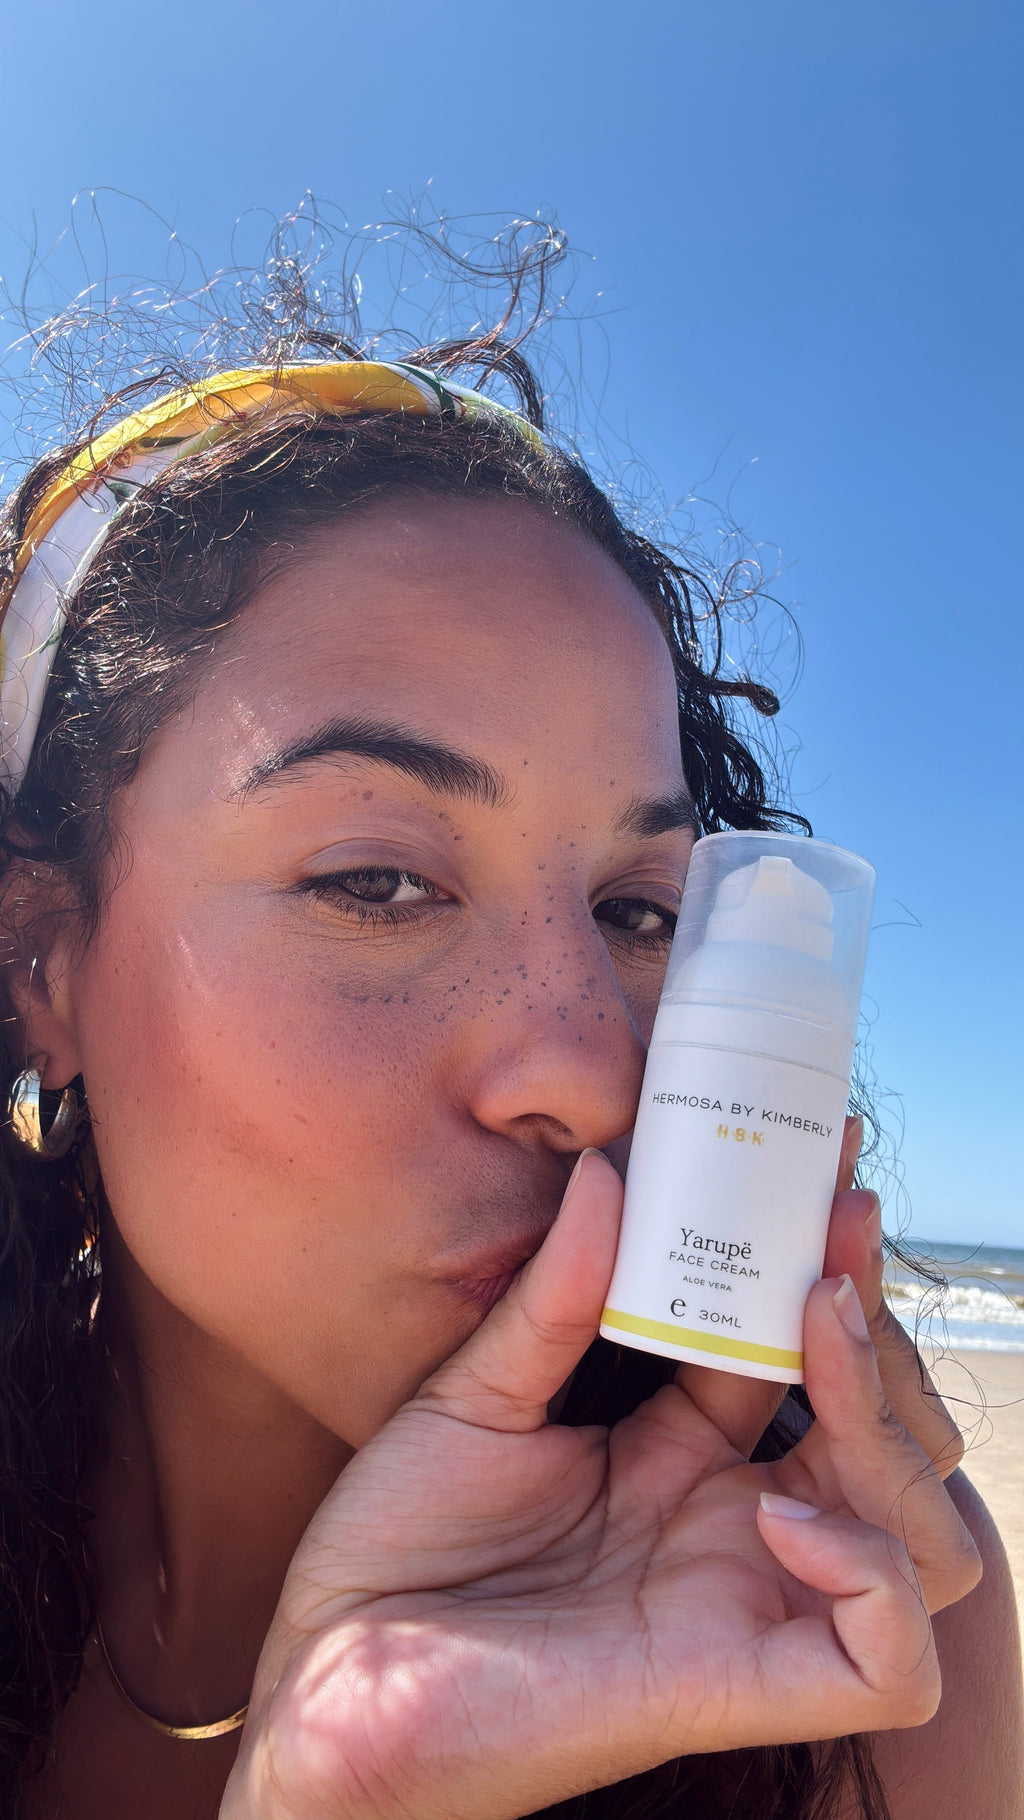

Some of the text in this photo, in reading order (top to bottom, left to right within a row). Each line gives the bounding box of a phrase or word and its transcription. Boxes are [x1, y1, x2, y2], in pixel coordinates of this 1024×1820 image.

[652, 1093, 833, 1138] HERMOSA BY KIMBERLY
[680, 1227, 752, 1261] Yarupë
[669, 1251, 760, 1279] FACE CREAM
[682, 1275, 732, 1292] ALOE VERA
[699, 1309, 742, 1328] 30ML
